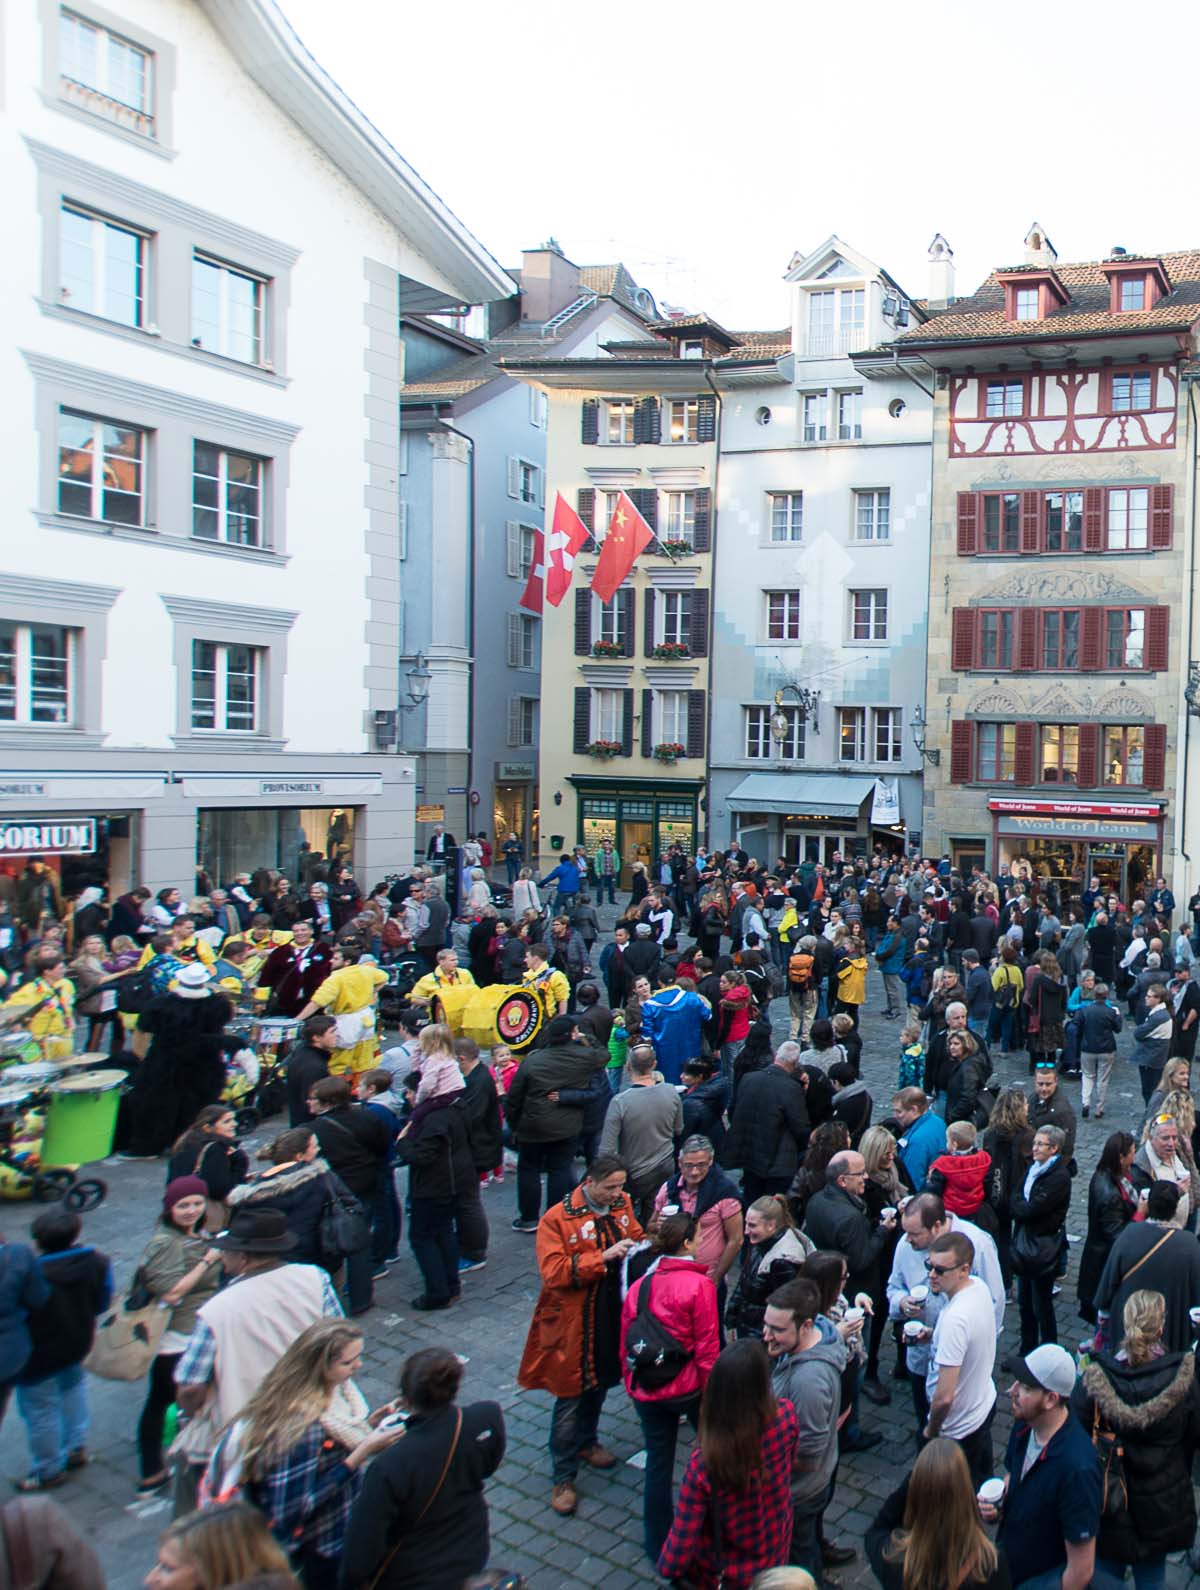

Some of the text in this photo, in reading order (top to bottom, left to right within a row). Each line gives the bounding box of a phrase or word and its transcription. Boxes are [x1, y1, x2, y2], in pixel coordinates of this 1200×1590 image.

[263, 783, 321, 792] PROVISORIUM
[1015, 819, 1139, 834] World of Jeans
